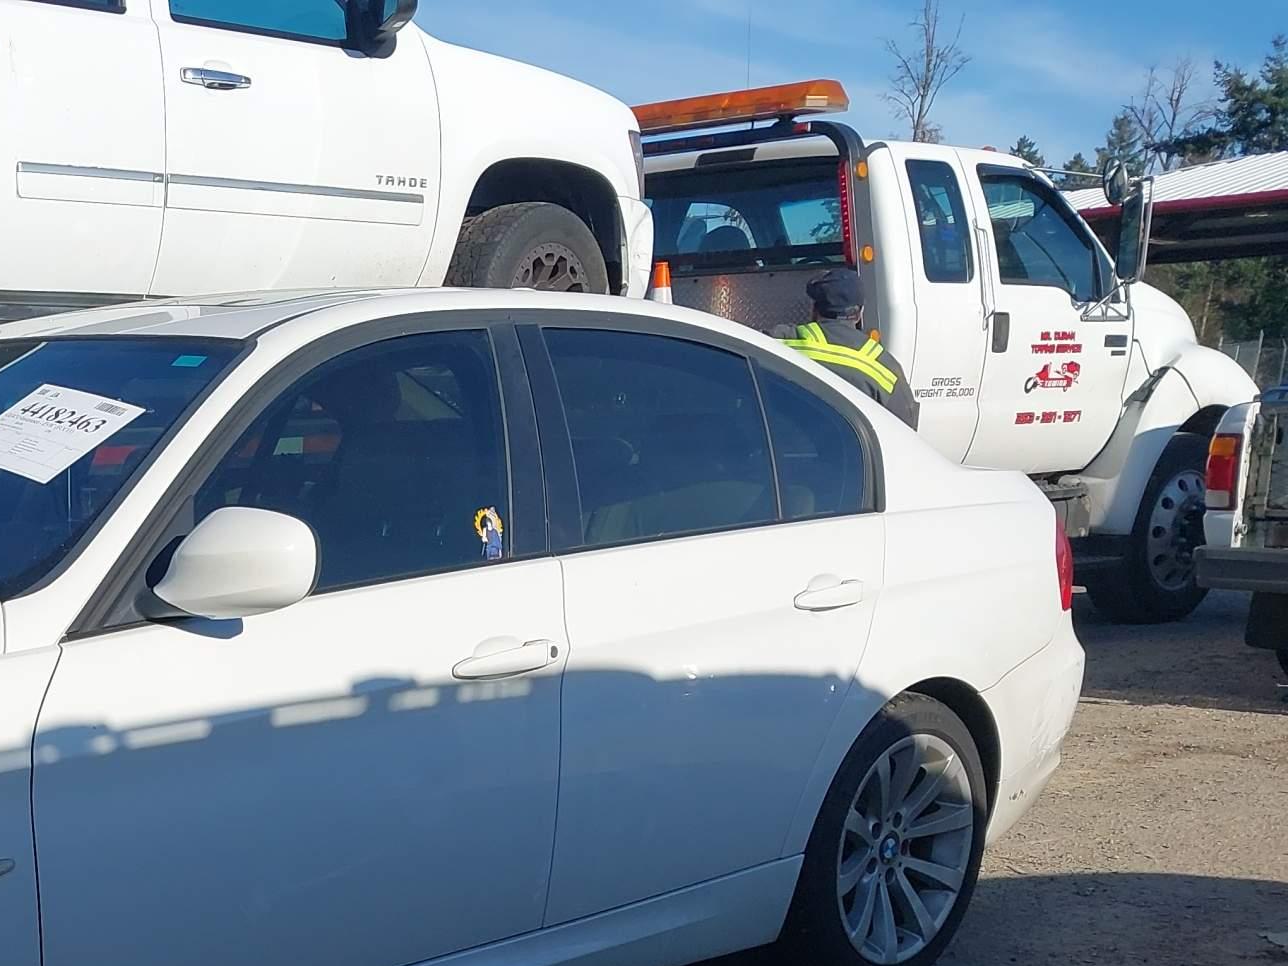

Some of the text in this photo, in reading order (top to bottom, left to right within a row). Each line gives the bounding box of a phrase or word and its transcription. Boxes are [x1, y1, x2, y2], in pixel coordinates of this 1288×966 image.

[376, 175, 428, 188] TAHOE
[931, 377, 962, 387] GROSS
[914, 387, 975, 398] WEIGHT 26,000
[20, 401, 109, 434] 44182463
